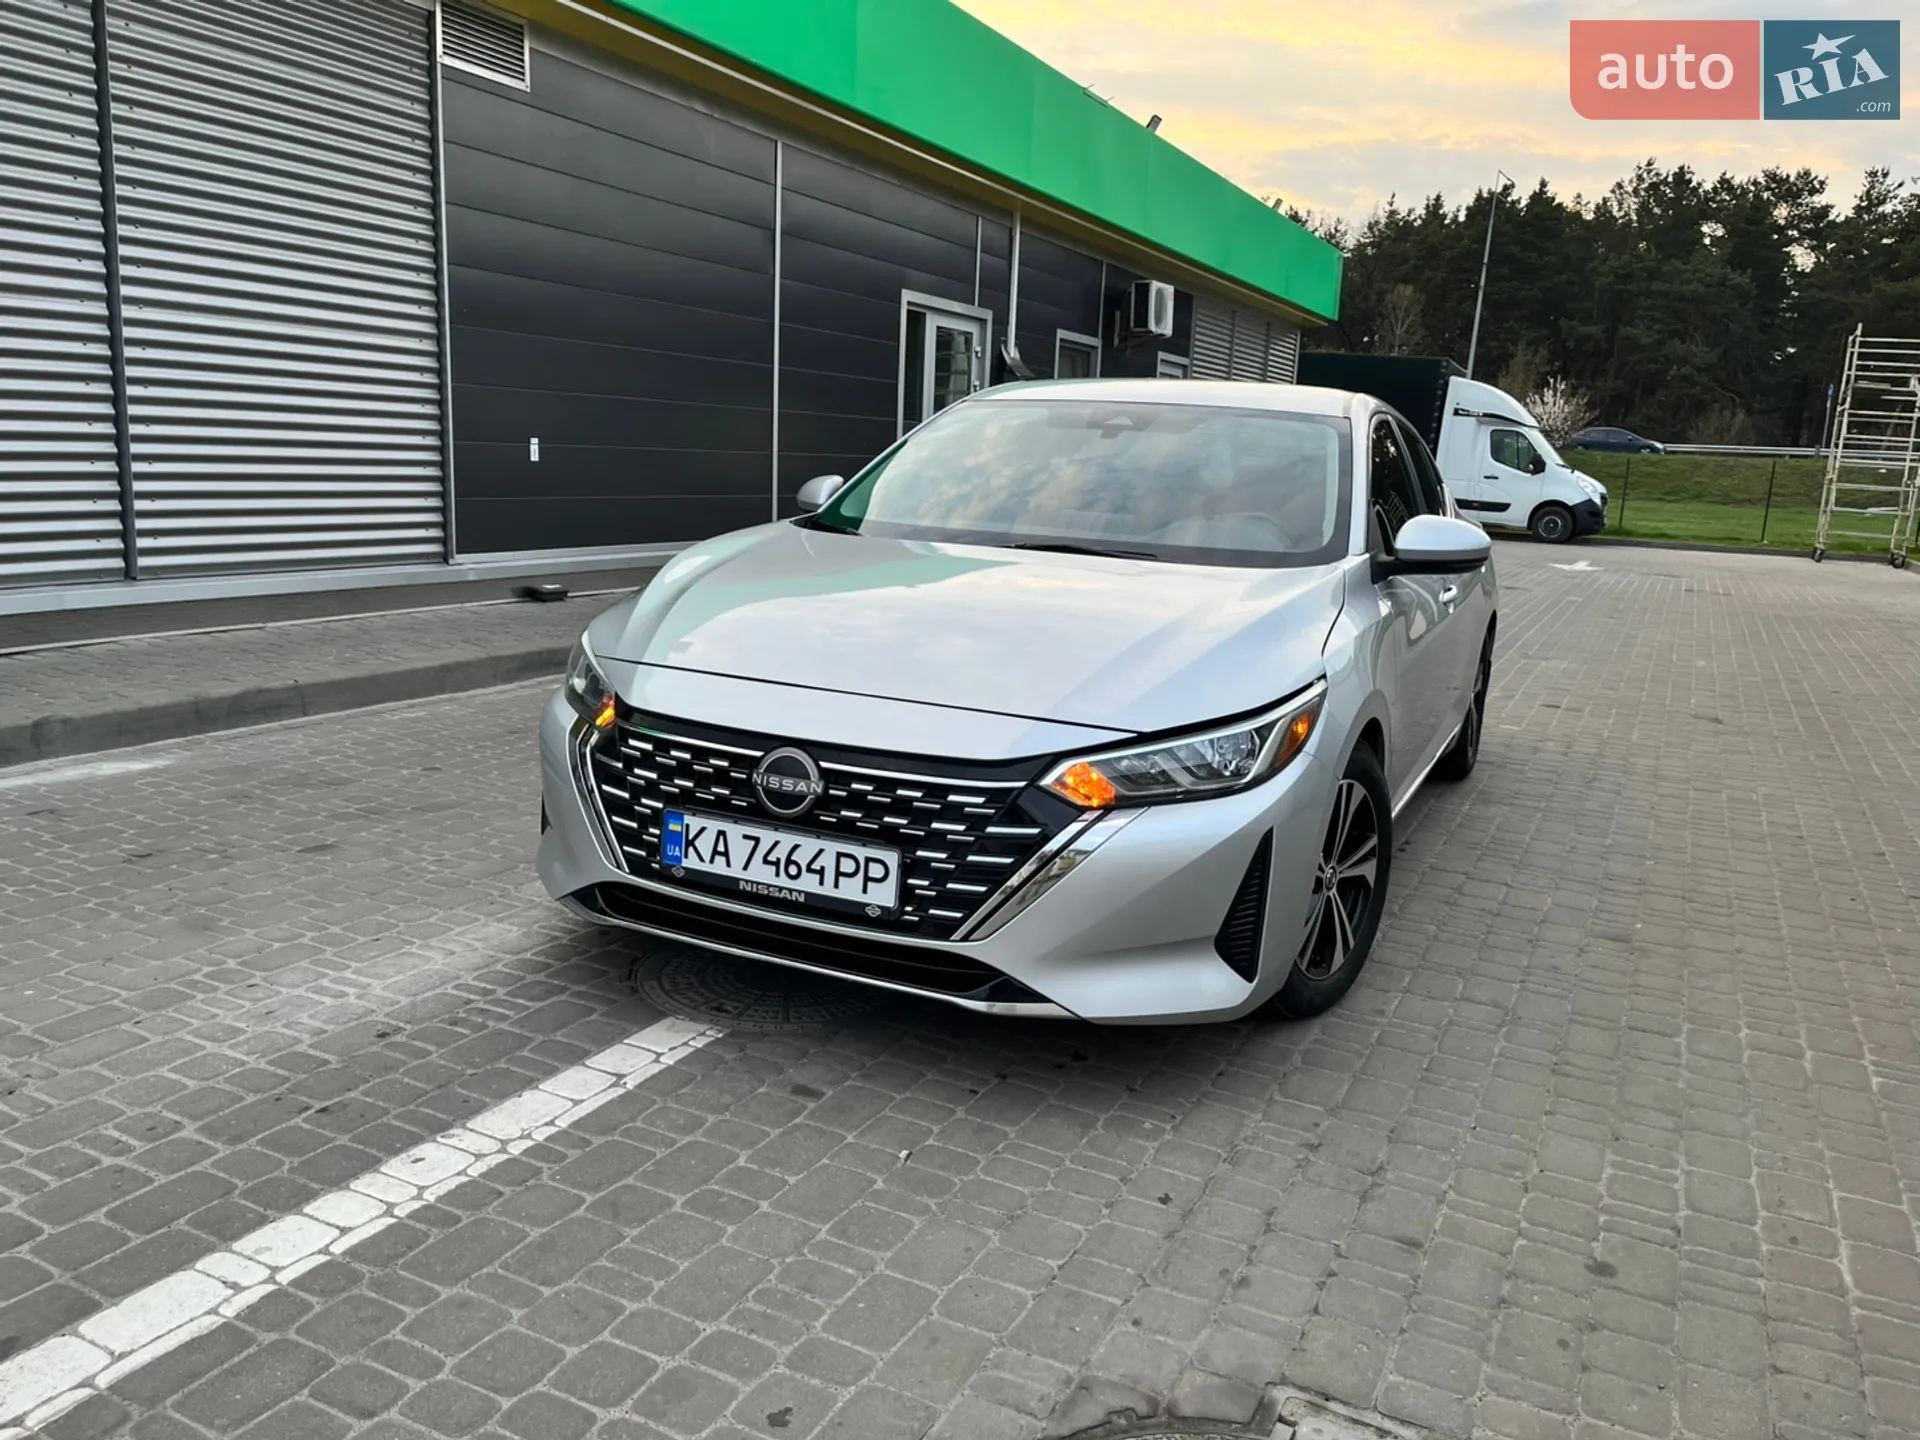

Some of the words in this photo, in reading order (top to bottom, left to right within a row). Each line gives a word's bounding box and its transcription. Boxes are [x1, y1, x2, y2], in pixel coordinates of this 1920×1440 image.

[752, 772, 823, 793] NISSAN
[666, 844, 681, 858] UA
[738, 880, 806, 902] NISSAN
